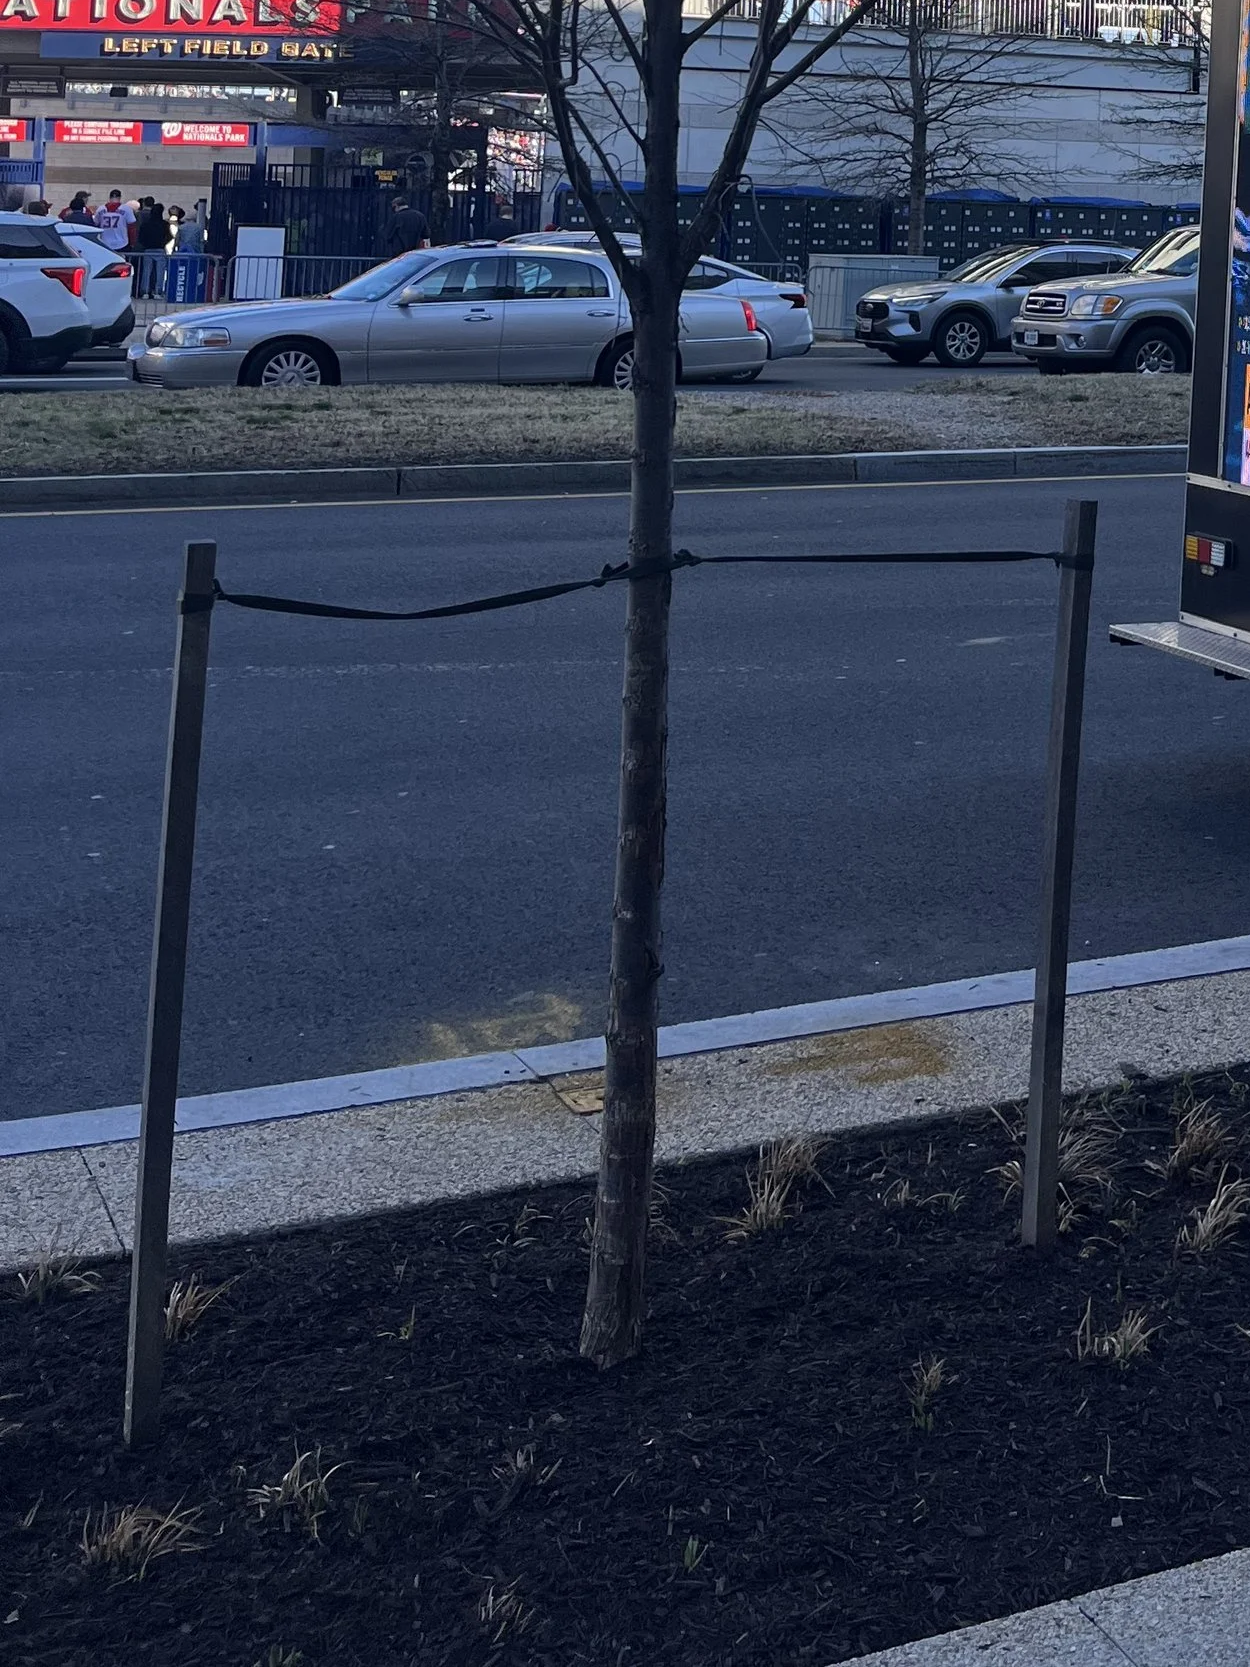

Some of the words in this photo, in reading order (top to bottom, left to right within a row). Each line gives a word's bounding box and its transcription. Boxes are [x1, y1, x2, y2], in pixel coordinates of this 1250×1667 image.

[104, 37, 178, 55] LEFT
[184, 39, 269, 56] FIELD
[281, 42, 355, 59] GATE
[183, 124, 220, 134] WELCOME
[222, 125, 232, 134] TO
[183, 133, 224, 142] NATIONALS
[225, 134, 246, 142] PARK
[103, 215, 120, 229] 37
[176, 265, 186, 302] RECYCLE
